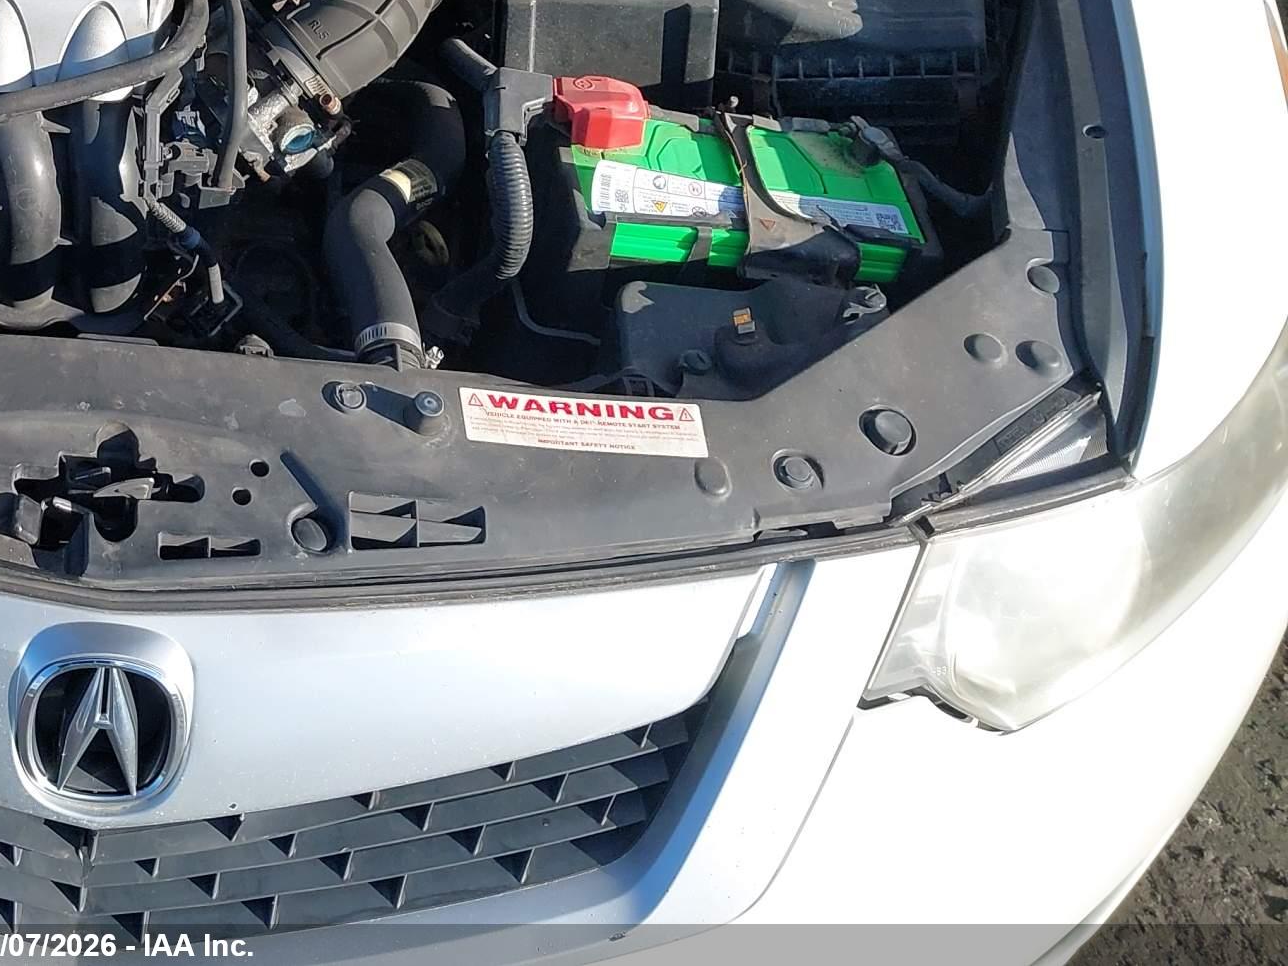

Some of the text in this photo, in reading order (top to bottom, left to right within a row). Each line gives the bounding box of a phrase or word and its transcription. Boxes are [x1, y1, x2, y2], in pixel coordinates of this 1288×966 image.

[487, 394, 674, 421] WARNING
[487, 410, 515, 419] VEHICLE
[516, 414, 552, 423] EQUIPPED
[553, 417, 572, 425] WITH
[597, 420, 627, 428] REMOTE
[628, 422, 651, 430] START
[652, 423, 681, 431] SYSTEM
[537, 438, 636, 451] IMPORTANT SAFETY NOTICE
